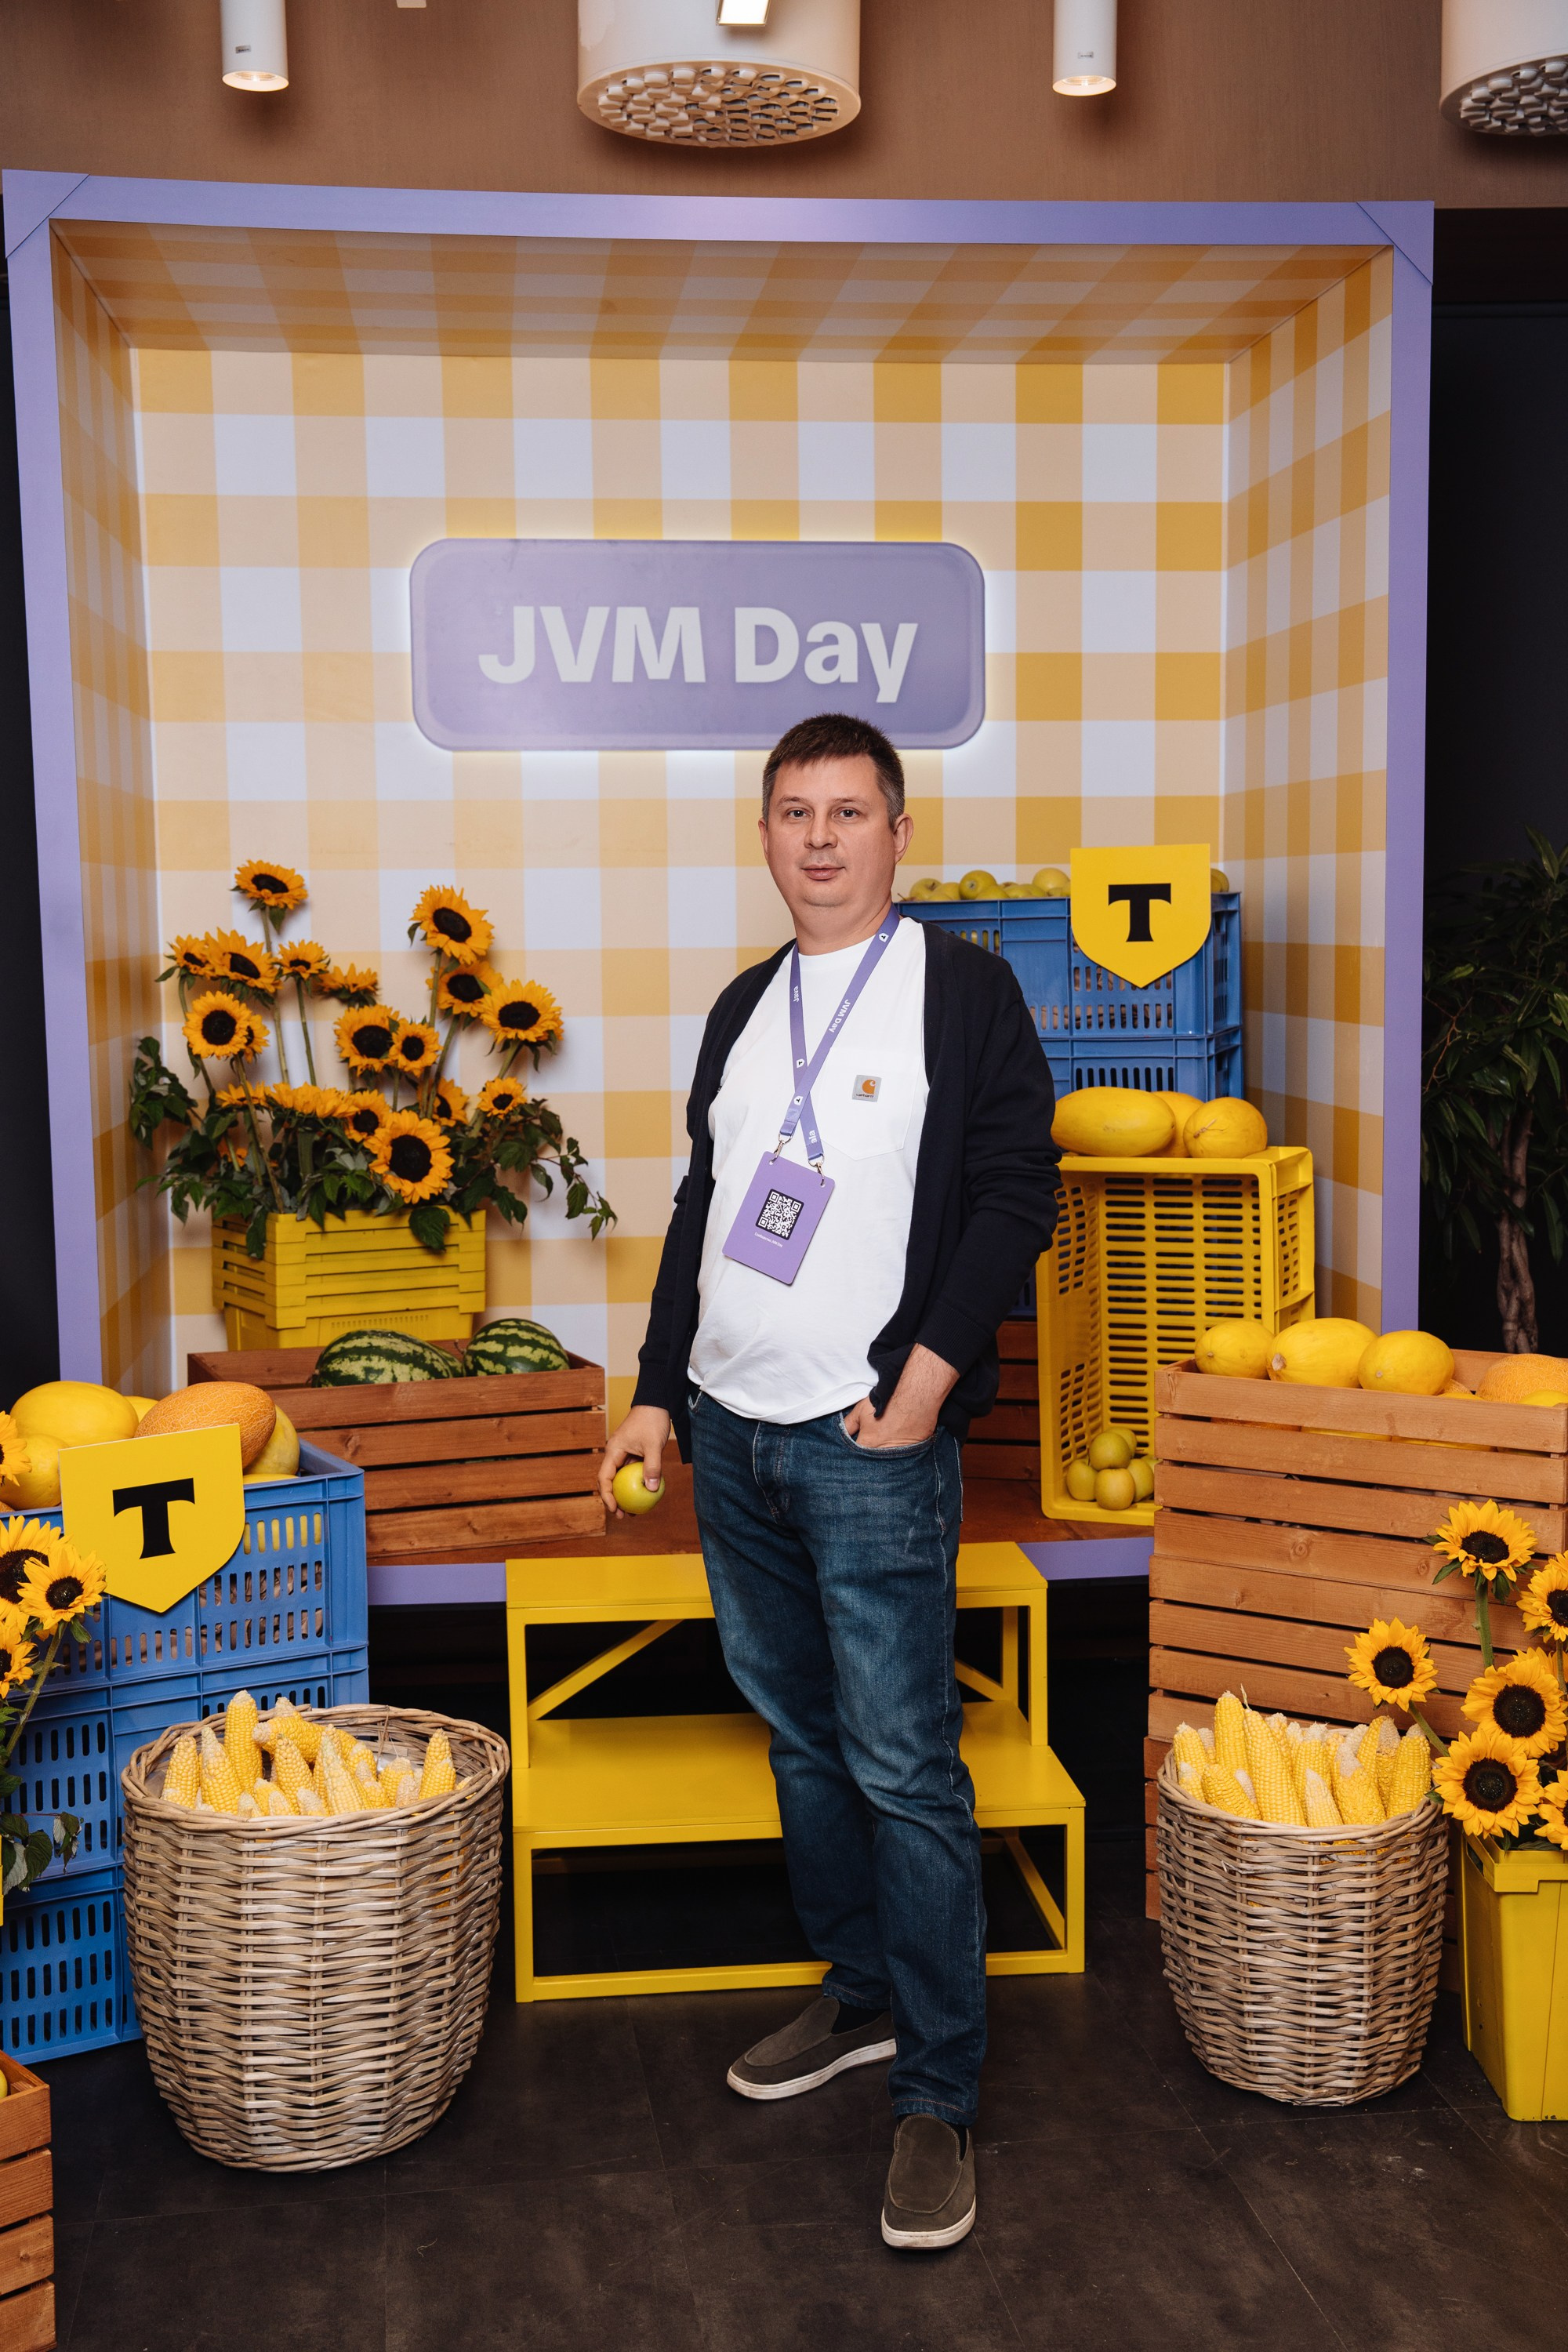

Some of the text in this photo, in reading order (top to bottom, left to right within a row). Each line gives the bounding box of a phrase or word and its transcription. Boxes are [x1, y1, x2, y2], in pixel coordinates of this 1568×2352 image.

[478, 606, 919, 703] JVM Day
[1108, 883, 1171, 942] T
[828, 999, 851, 1033] JVM Day
[112, 1477, 195, 1559] T
